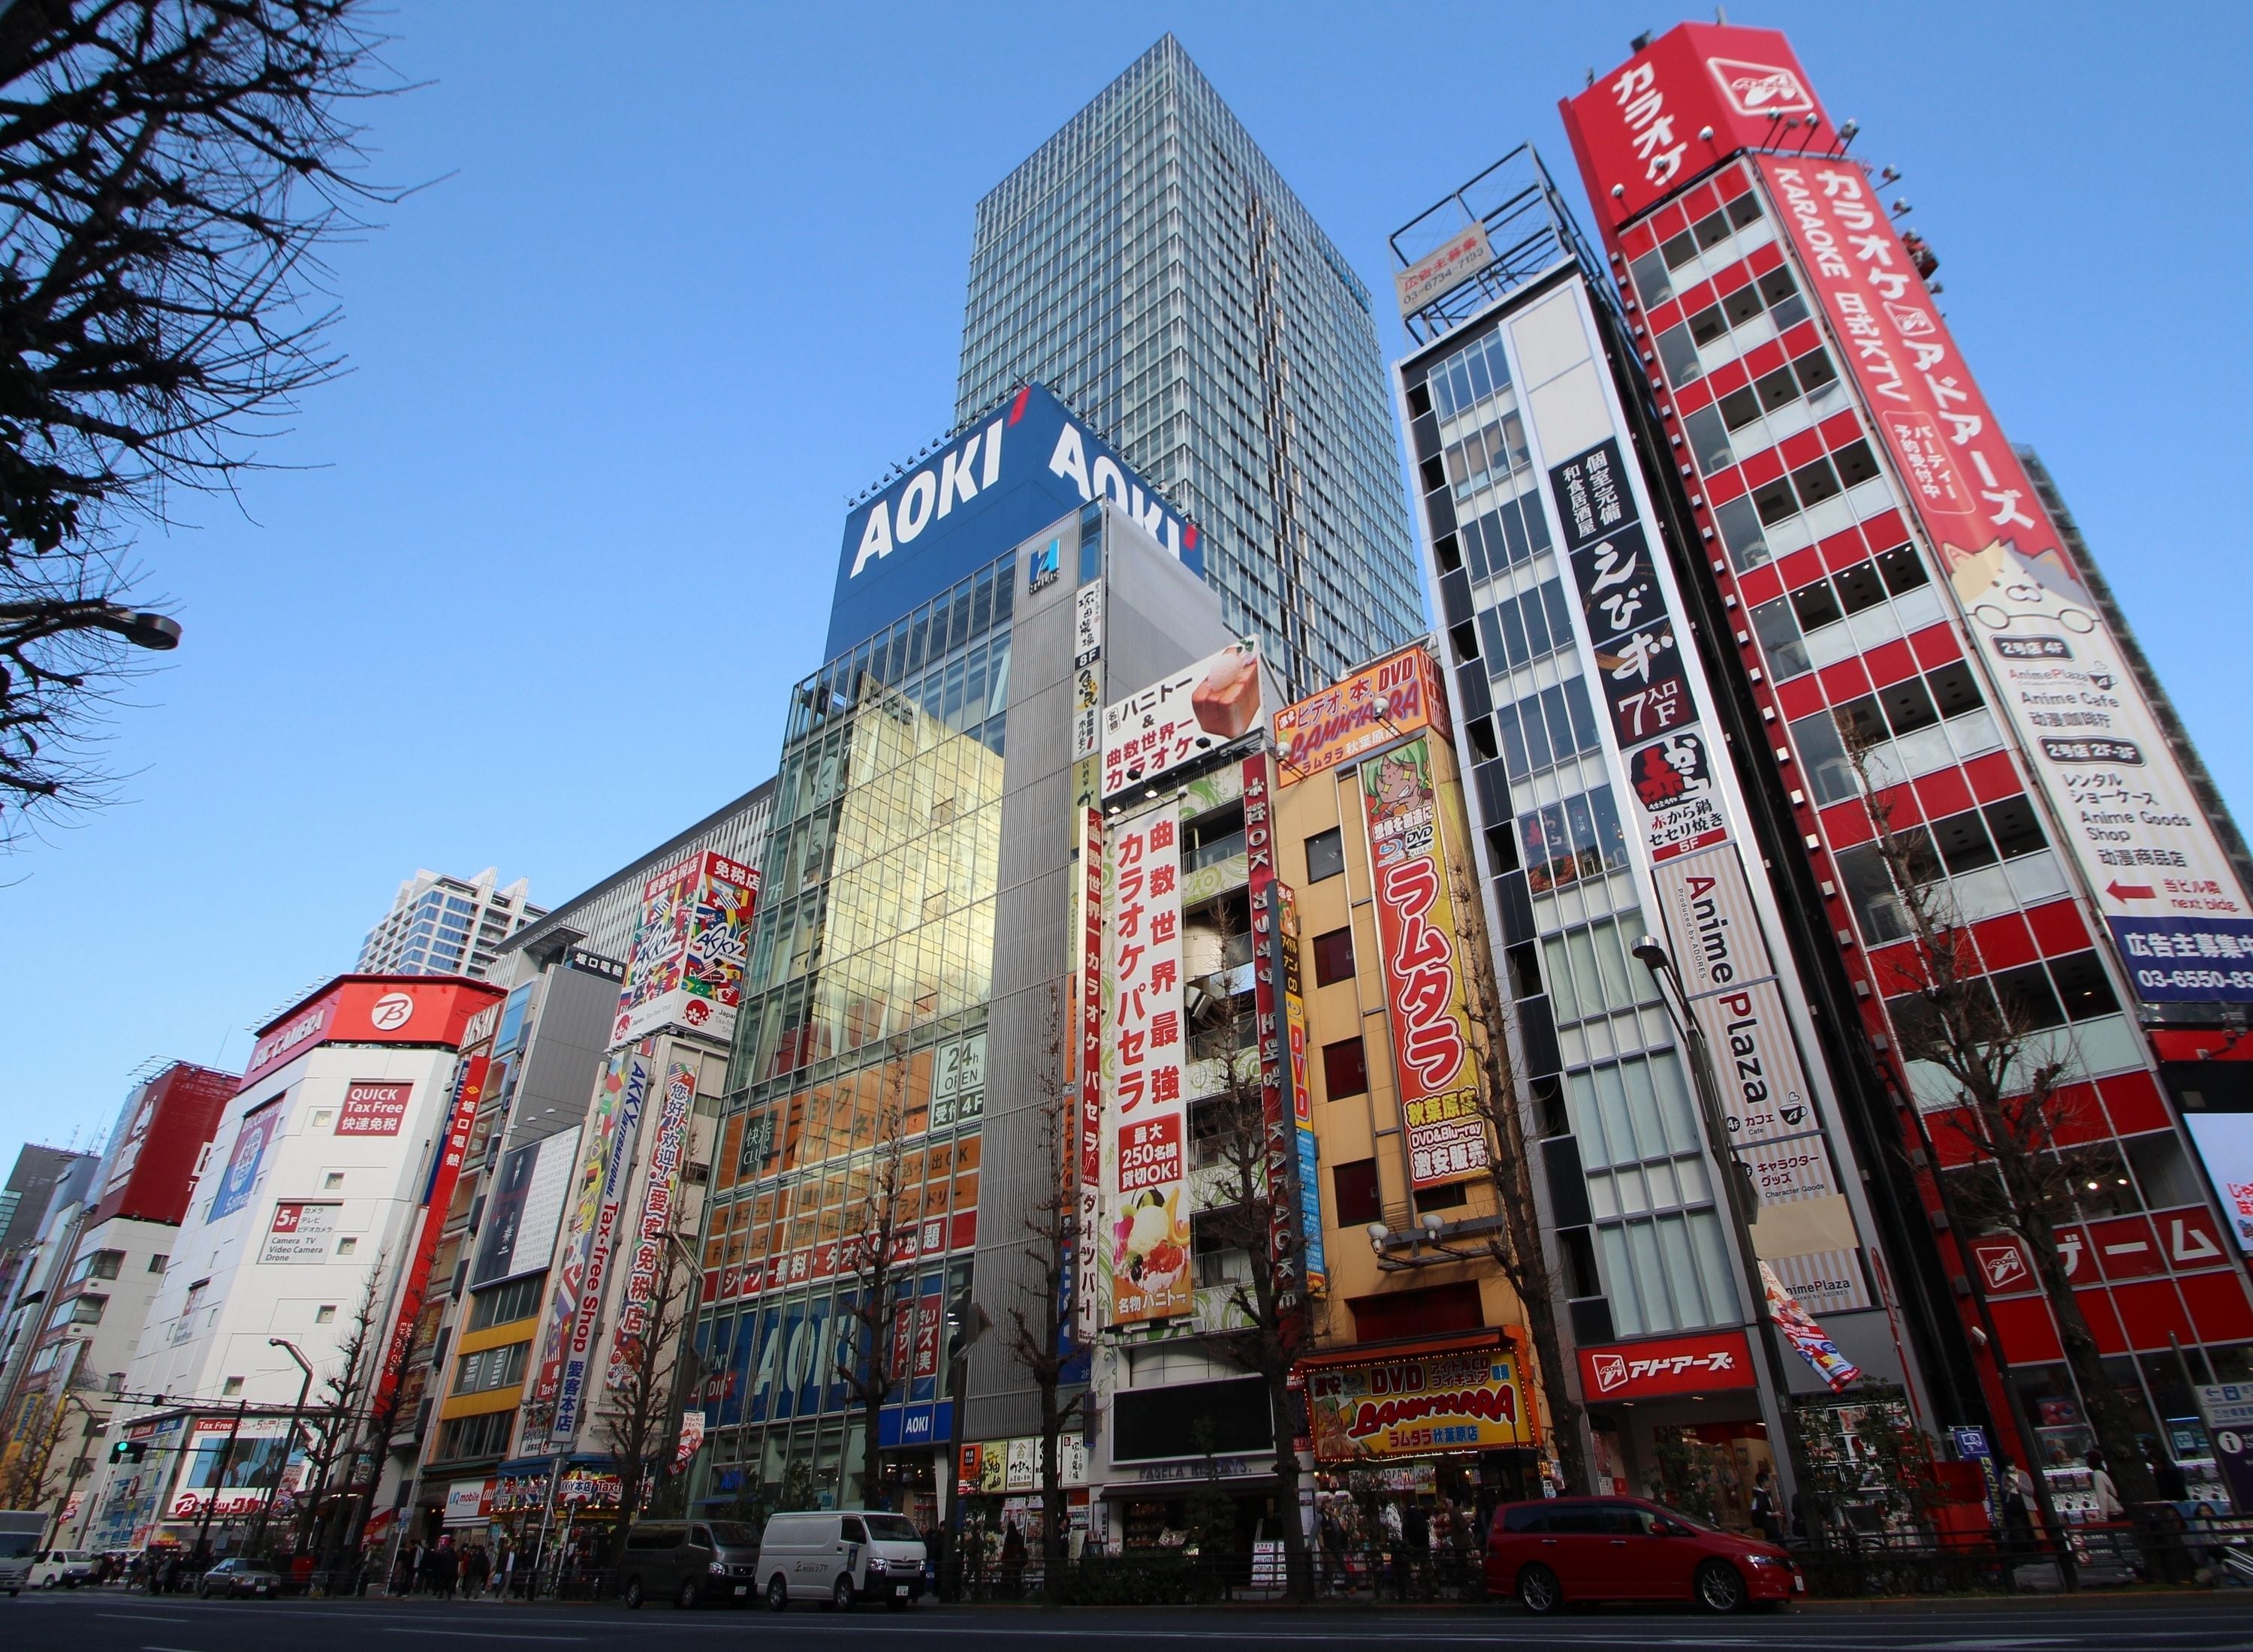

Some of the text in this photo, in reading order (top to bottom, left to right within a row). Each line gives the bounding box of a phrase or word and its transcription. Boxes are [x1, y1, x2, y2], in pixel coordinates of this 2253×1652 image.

[1612, 61, 1687, 185] カラオケ
[1774, 167, 1850, 279] KARAOKE
[1814, 169, 1910, 300] カラオケ
[1403, 247, 1484, 303] 03-6734-7133
[1404, 234, 1478, 293] 広告主募集
[1902, 338, 2036, 530] アドアーズ
[1914, 425, 1957, 499] パーティー
[850, 418, 1003, 580] AOKI
[1049, 422, 1181, 561] AOKI
[1585, 450, 1622, 526] 個室完備
[1562, 465, 1597, 539] 和食居酒屋
[1079, 649, 1097, 668] 8F
[1377, 654, 1416, 692] DVD
[1122, 677, 1193, 722] ハニトー
[2021, 691, 2120, 708] Anime Cafe
[1142, 713, 1156, 729] &
[1283, 679, 1419, 770] LAMMTARA
[1106, 718, 1194, 770] 曲数世界一
[1302, 722, 1401, 774] ラムタラ 秋葉原店
[1105, 736, 1194, 793] カラオケ
[2062, 773, 2123, 788] レンタル
[2071, 790, 2160, 806] ショーケース
[1651, 799, 1713, 831] 赤から鍋
[2080, 810, 2192, 828] Anime Goods
[1407, 825, 1434, 844] DVD
[1648, 812, 1724, 846] セセリ焼き
[2088, 827, 2131, 843] Shop
[1410, 845, 1433, 856] VIDEO
[1678, 837, 1700, 853] 5F
[713, 859, 761, 892] 免税店
[2170, 898, 2203, 910] next
[1677, 888, 1707, 980] Produced by ADORES
[1684, 876, 1733, 984] Anime
[573, 951, 624, 978] 坂口電熱
[1117, 832, 1148, 1114] カラオケパセラ
[1148, 820, 1180, 1105] 曲数世界最強
[1283, 955, 1299, 972] アニメ
[1388, 858, 1461, 1087] ラムタラ
[1287, 976, 1298, 993] CD
[251, 1009, 326, 1072] BIC CAMERA
[1718, 990, 1768, 1104] Plaza
[948, 1042, 980, 1074] 24h
[944, 1069, 979, 1092] OPEN
[1290, 1023, 1310, 1123] DVD
[348, 1101, 403, 1114] Tax Free
[351, 1088, 400, 1102] QUICK
[1407, 1087, 1478, 1127] 秋葉原店
[342, 1116, 398, 1132] 快速免税
[445, 1099, 477, 1168] 坂口電熱
[605, 1060, 647, 1198] AKKY INTERNATIONAL
[1745, 1113, 1775, 1127] カフェ
[1748, 1127, 1764, 1136] Cafe
[1133, 1123, 1163, 1145] 最大
[1122, 1141, 1178, 1167] 250名様
[1413, 1139, 1488, 1180] 激安販売
[1757, 1156, 1820, 1173] キャラクター
[1122, 1162, 1178, 1190] 貸切OK!
[1760, 1172, 1793, 1187] グッズ
[1765, 1183, 1826, 1198] Character Goods
[276, 1209, 298, 1227] 5F
[303, 1207, 325, 1215] カメラ
[1266, 1120, 1298, 1310] KARAOKE
[269, 1246, 323, 1254] Video Camera
[271, 1237, 317, 1245] Camera TV
[265, 1253, 290, 1262] Drone
[573, 1201, 620, 1355] Tax-free Shop
[1784, 1279, 1850, 1295] nimePlaza
[1117, 1291, 1187, 1315] 名物 ハニトー
[754, 1314, 858, 1397] AOKI
[1628, 1352, 1733, 1379] アドアーズ
[1370, 1364, 1425, 1396] DVD
[554, 1360, 586, 1433] 愛客本店
[198, 1421, 234, 1431] Tax Free
[905, 1417, 930, 1434] AOKI
[1389, 1425, 1479, 1449] ラムタラ 秋葉原店
[1139, 1463, 1184, 1480] PASELA
[449, 1491, 481, 1505] UQ mobile
[481, 1486, 496, 1501] au
